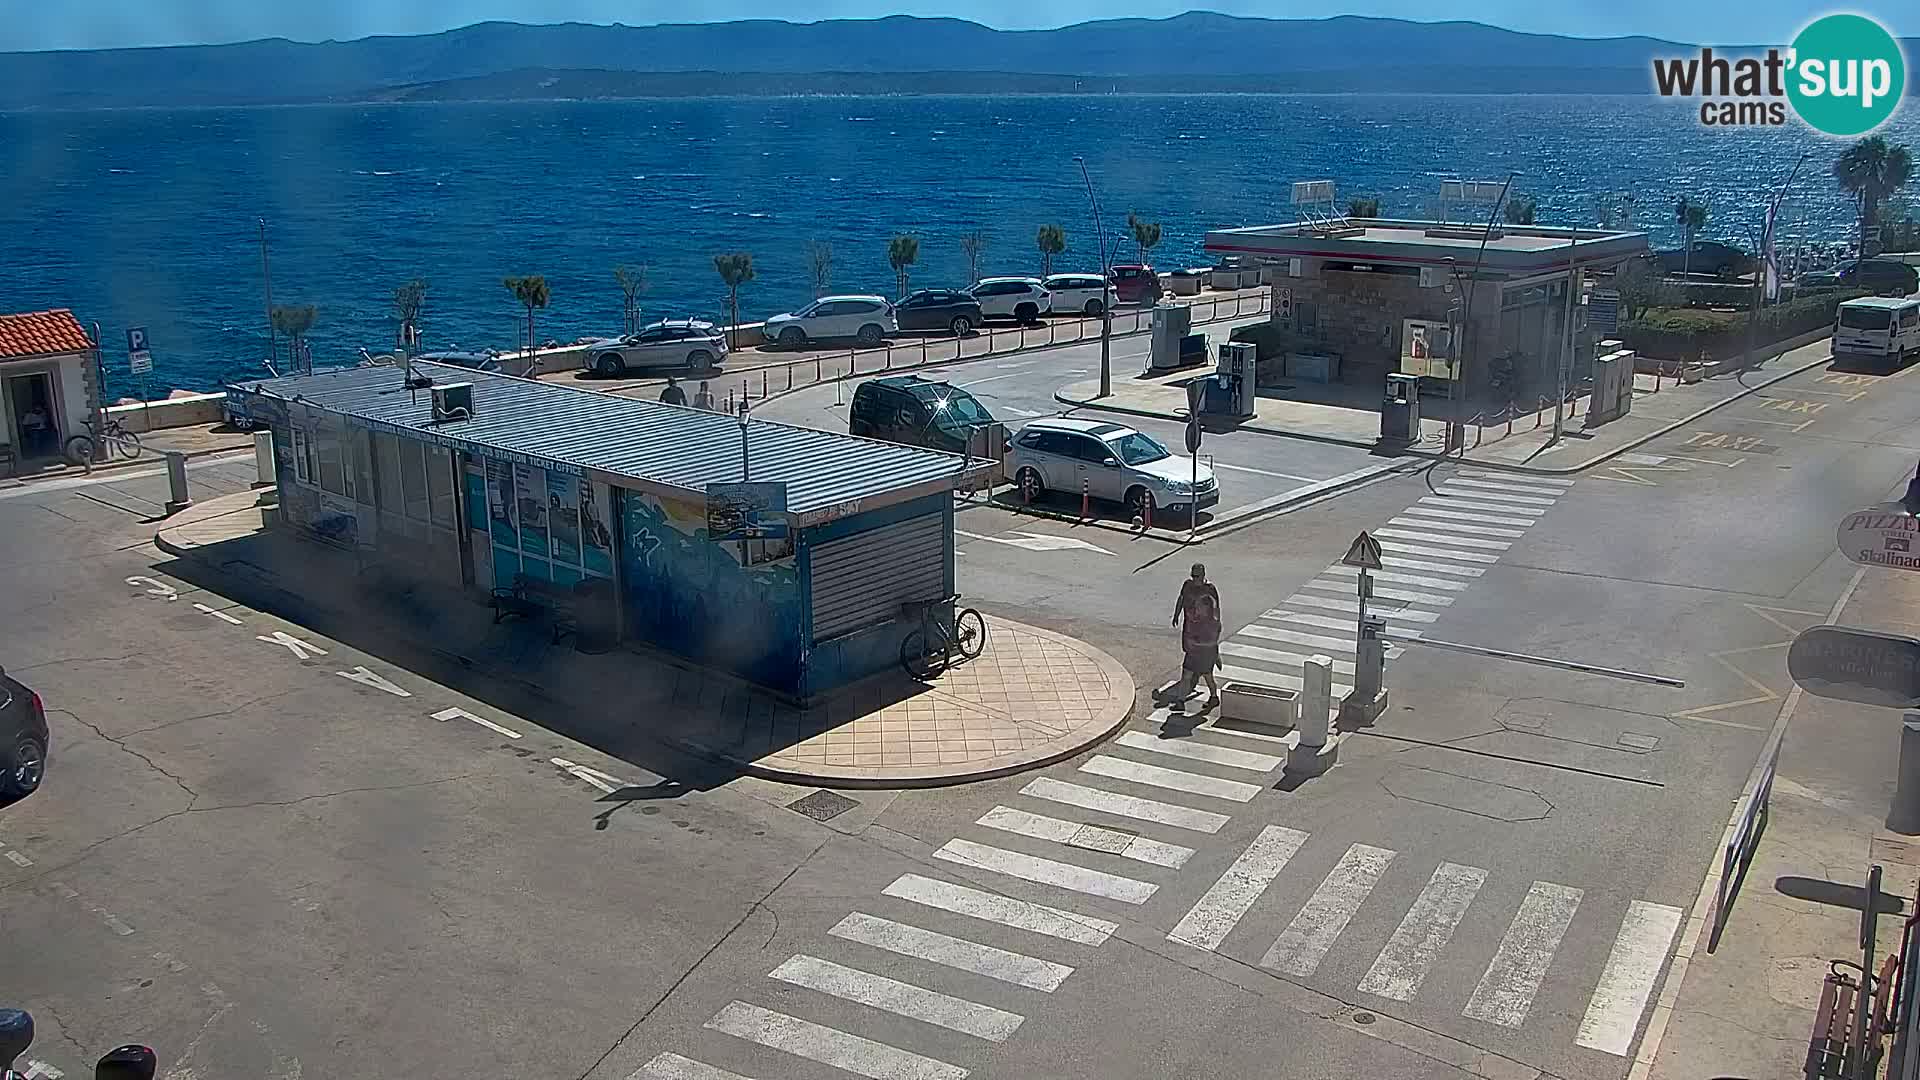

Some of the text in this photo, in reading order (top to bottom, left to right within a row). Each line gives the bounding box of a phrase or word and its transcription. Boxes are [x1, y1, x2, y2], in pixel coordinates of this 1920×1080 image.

[131, 331, 143, 349] P
[1759, 400, 1829, 414] TAXI
[1684, 431, 1765, 449] TAXI
[495, 449, 527, 464] STATION
[528, 456, 554, 470] TICKET
[556, 463, 583, 476] OFFICE
[1847, 514, 1920, 533] PIZZE
